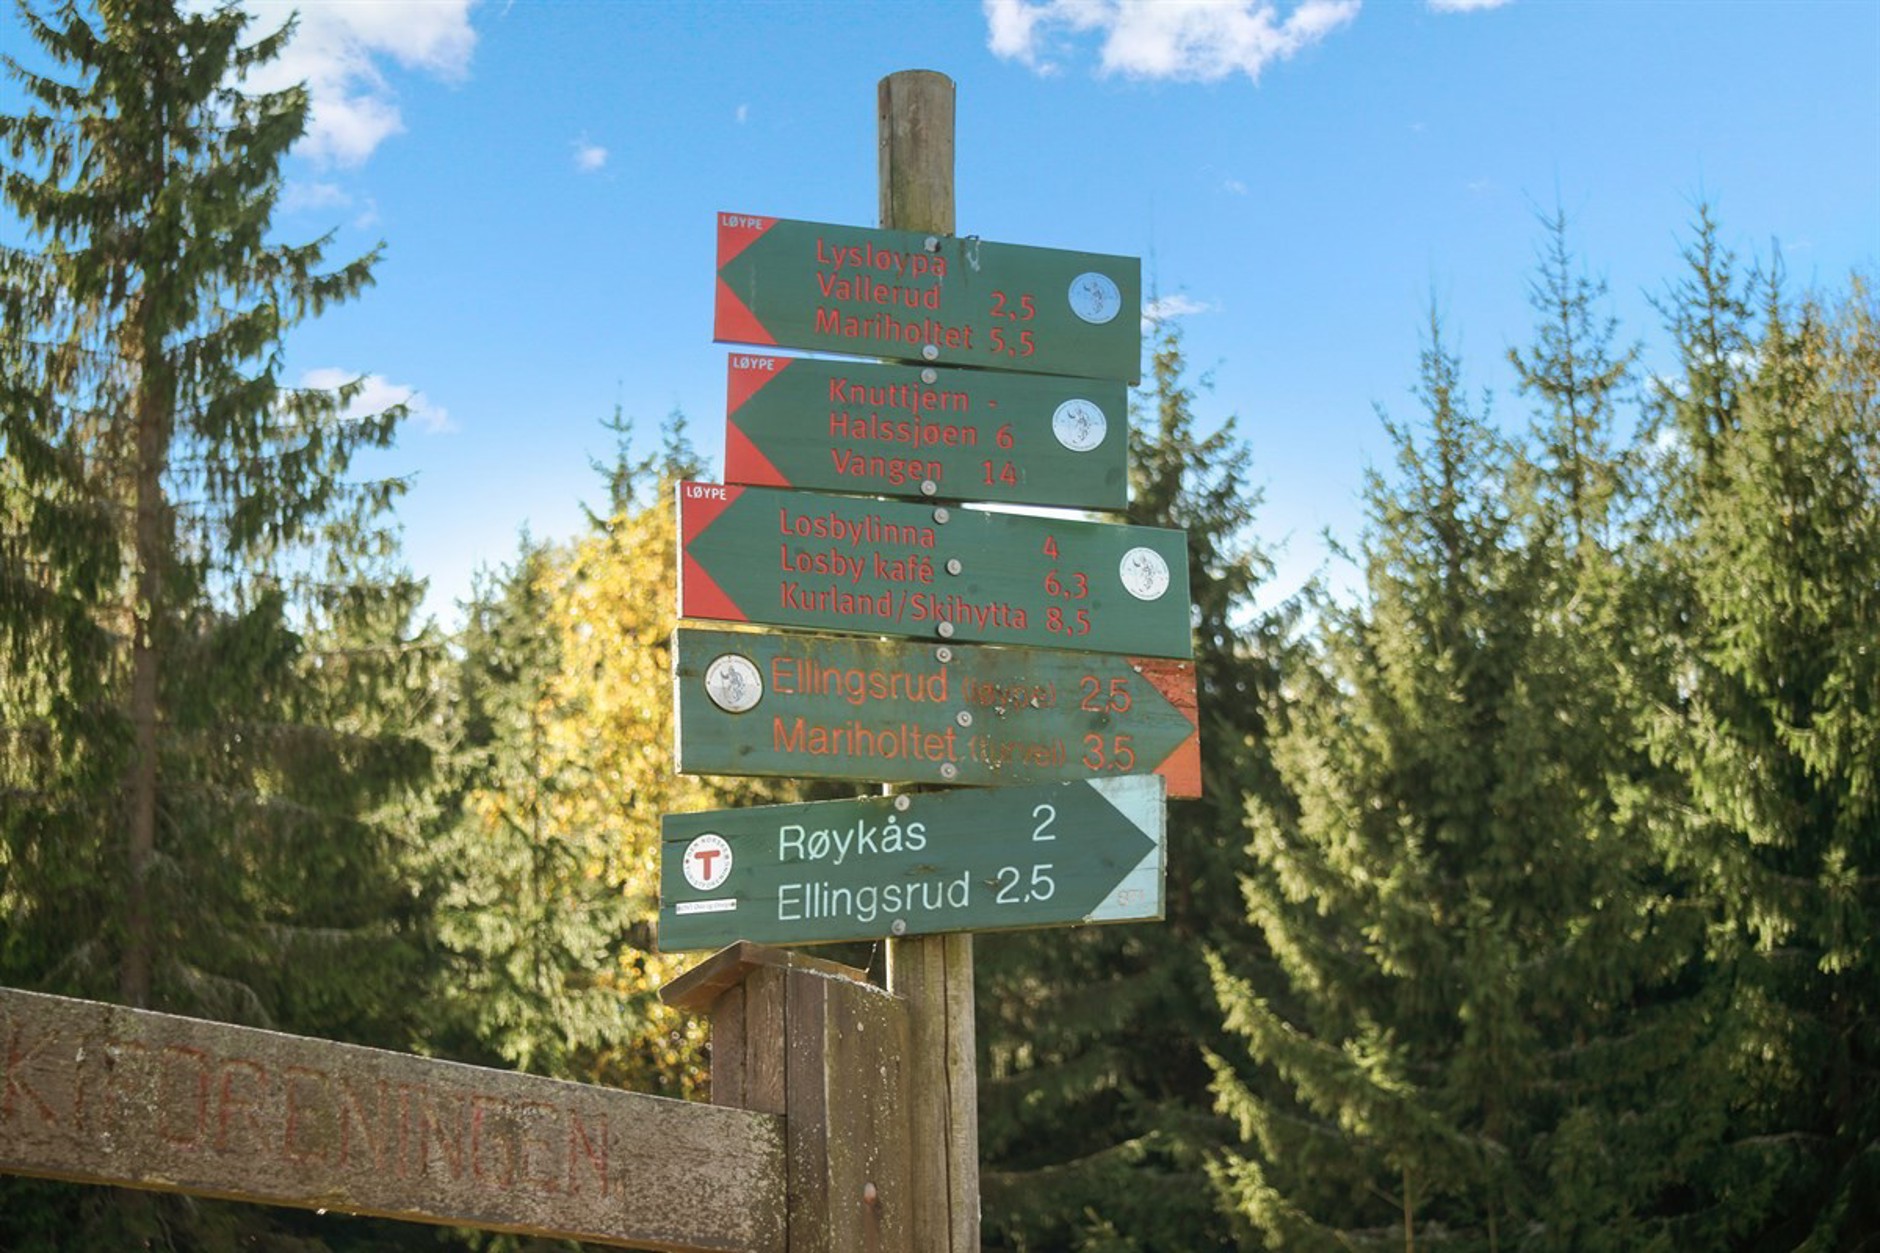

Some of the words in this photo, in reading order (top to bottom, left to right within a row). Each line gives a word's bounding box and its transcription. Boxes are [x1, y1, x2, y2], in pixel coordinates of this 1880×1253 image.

[722, 215, 763, 230] LØYPE
[816, 237, 948, 279] Lysløypa
[817, 271, 942, 310] Vallerud
[989, 292, 1036, 321] 2,5
[814, 307, 973, 349] Mariholtet
[989, 327, 1036, 356] 5,5
[733, 356, 775, 371] LØYPE
[829, 378, 970, 414] Knuttjern
[829, 411, 979, 449] Halssjøen
[995, 424, 1015, 449] 6
[830, 448, 943, 487] Vangen
[982, 459, 1017, 487] 14
[686, 485, 727, 501] LØYPE
[779, 508, 936, 548] Losbylinna
[1043, 535, 1060, 560] 4
[780, 543, 866, 585] Losby
[873, 552, 936, 586] kafé
[1045, 569, 1090, 600] 6,3
[780, 581, 1028, 631] Kurland/Skihytta
[1045, 607, 1092, 638] 8,5
[772, 656, 948, 705] Ellingsrud
[1080, 675, 1132, 715] 2,5
[773, 715, 958, 762] Mariholtet
[1083, 733, 1136, 772] 3,5
[778, 815, 928, 865] Røykås
[1031, 803, 1057, 843] 2
[694, 849, 721, 881] T
[778, 870, 971, 923] Ellingsrud
[995, 863, 1056, 906] 2,5
